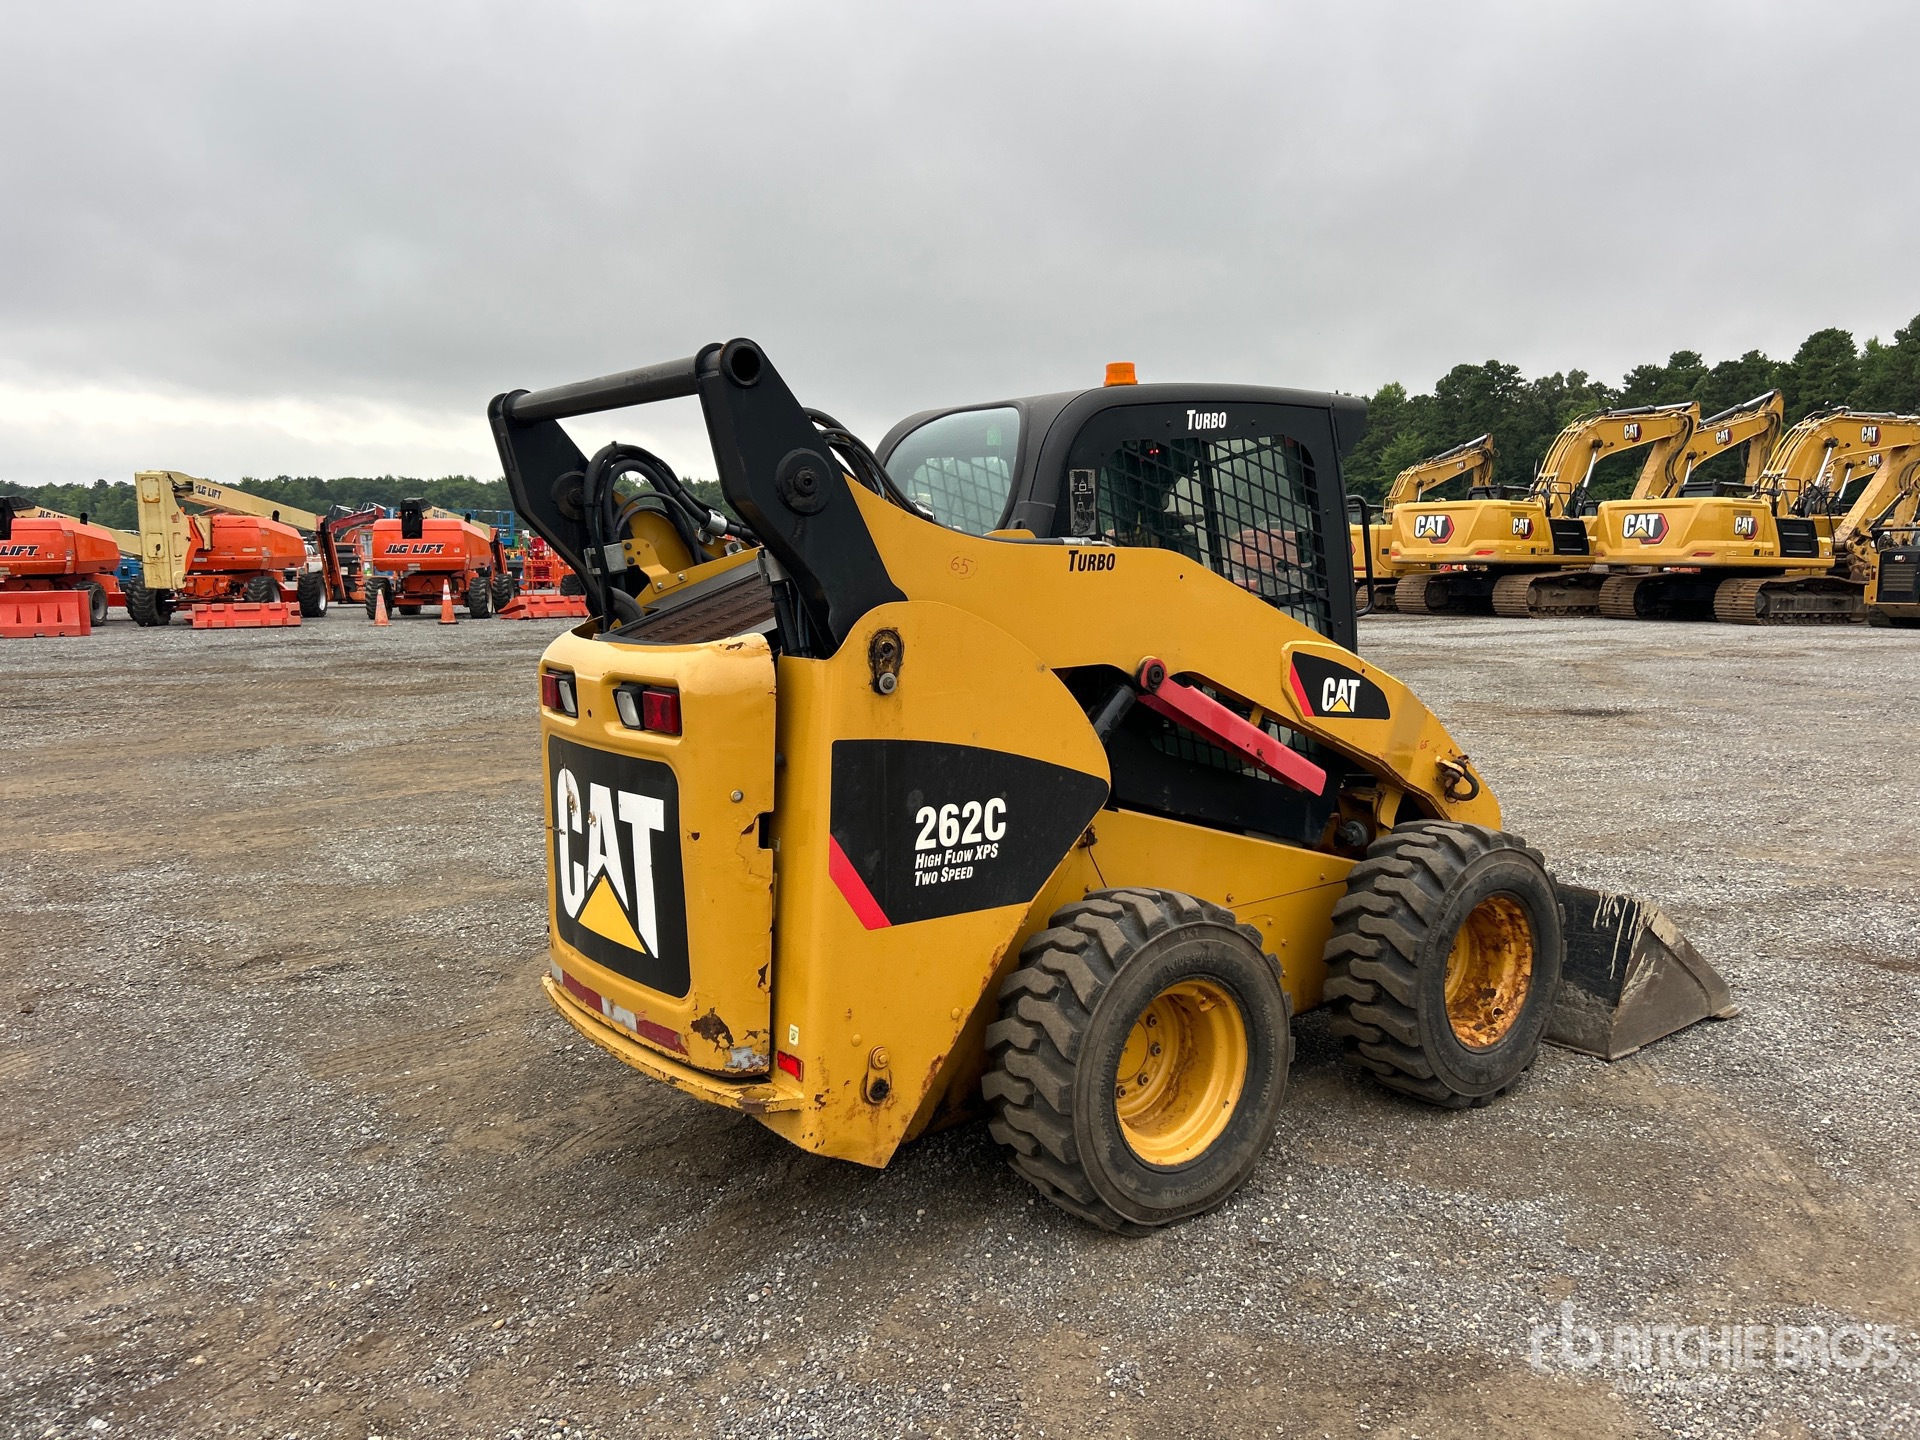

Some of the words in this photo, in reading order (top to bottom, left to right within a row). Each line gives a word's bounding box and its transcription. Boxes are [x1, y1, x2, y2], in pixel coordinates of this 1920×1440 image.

[1624, 423, 1639, 440] CAT
[1715, 428, 1730, 444] CAT
[1861, 426, 1878, 443] CAT
[1868, 453, 1880, 467] CAT
[207, 487, 222, 500] LIFT
[1415, 515, 1447, 538] CAT
[1511, 517, 1530, 536] CAT
[1622, 513, 1659, 539] CAT
[1734, 516, 1754, 535] CAT
[0, 545, 39, 556] LIFT
[411, 543, 445, 554] LIFT
[950, 556, 974, 575] 65
[1321, 676, 1361, 713] CAT
[915, 797, 1006, 850] 262C
[974, 843, 999, 861] XPS
[557, 768, 665, 959] CAT
[1178, 928, 1200, 941] BKT
